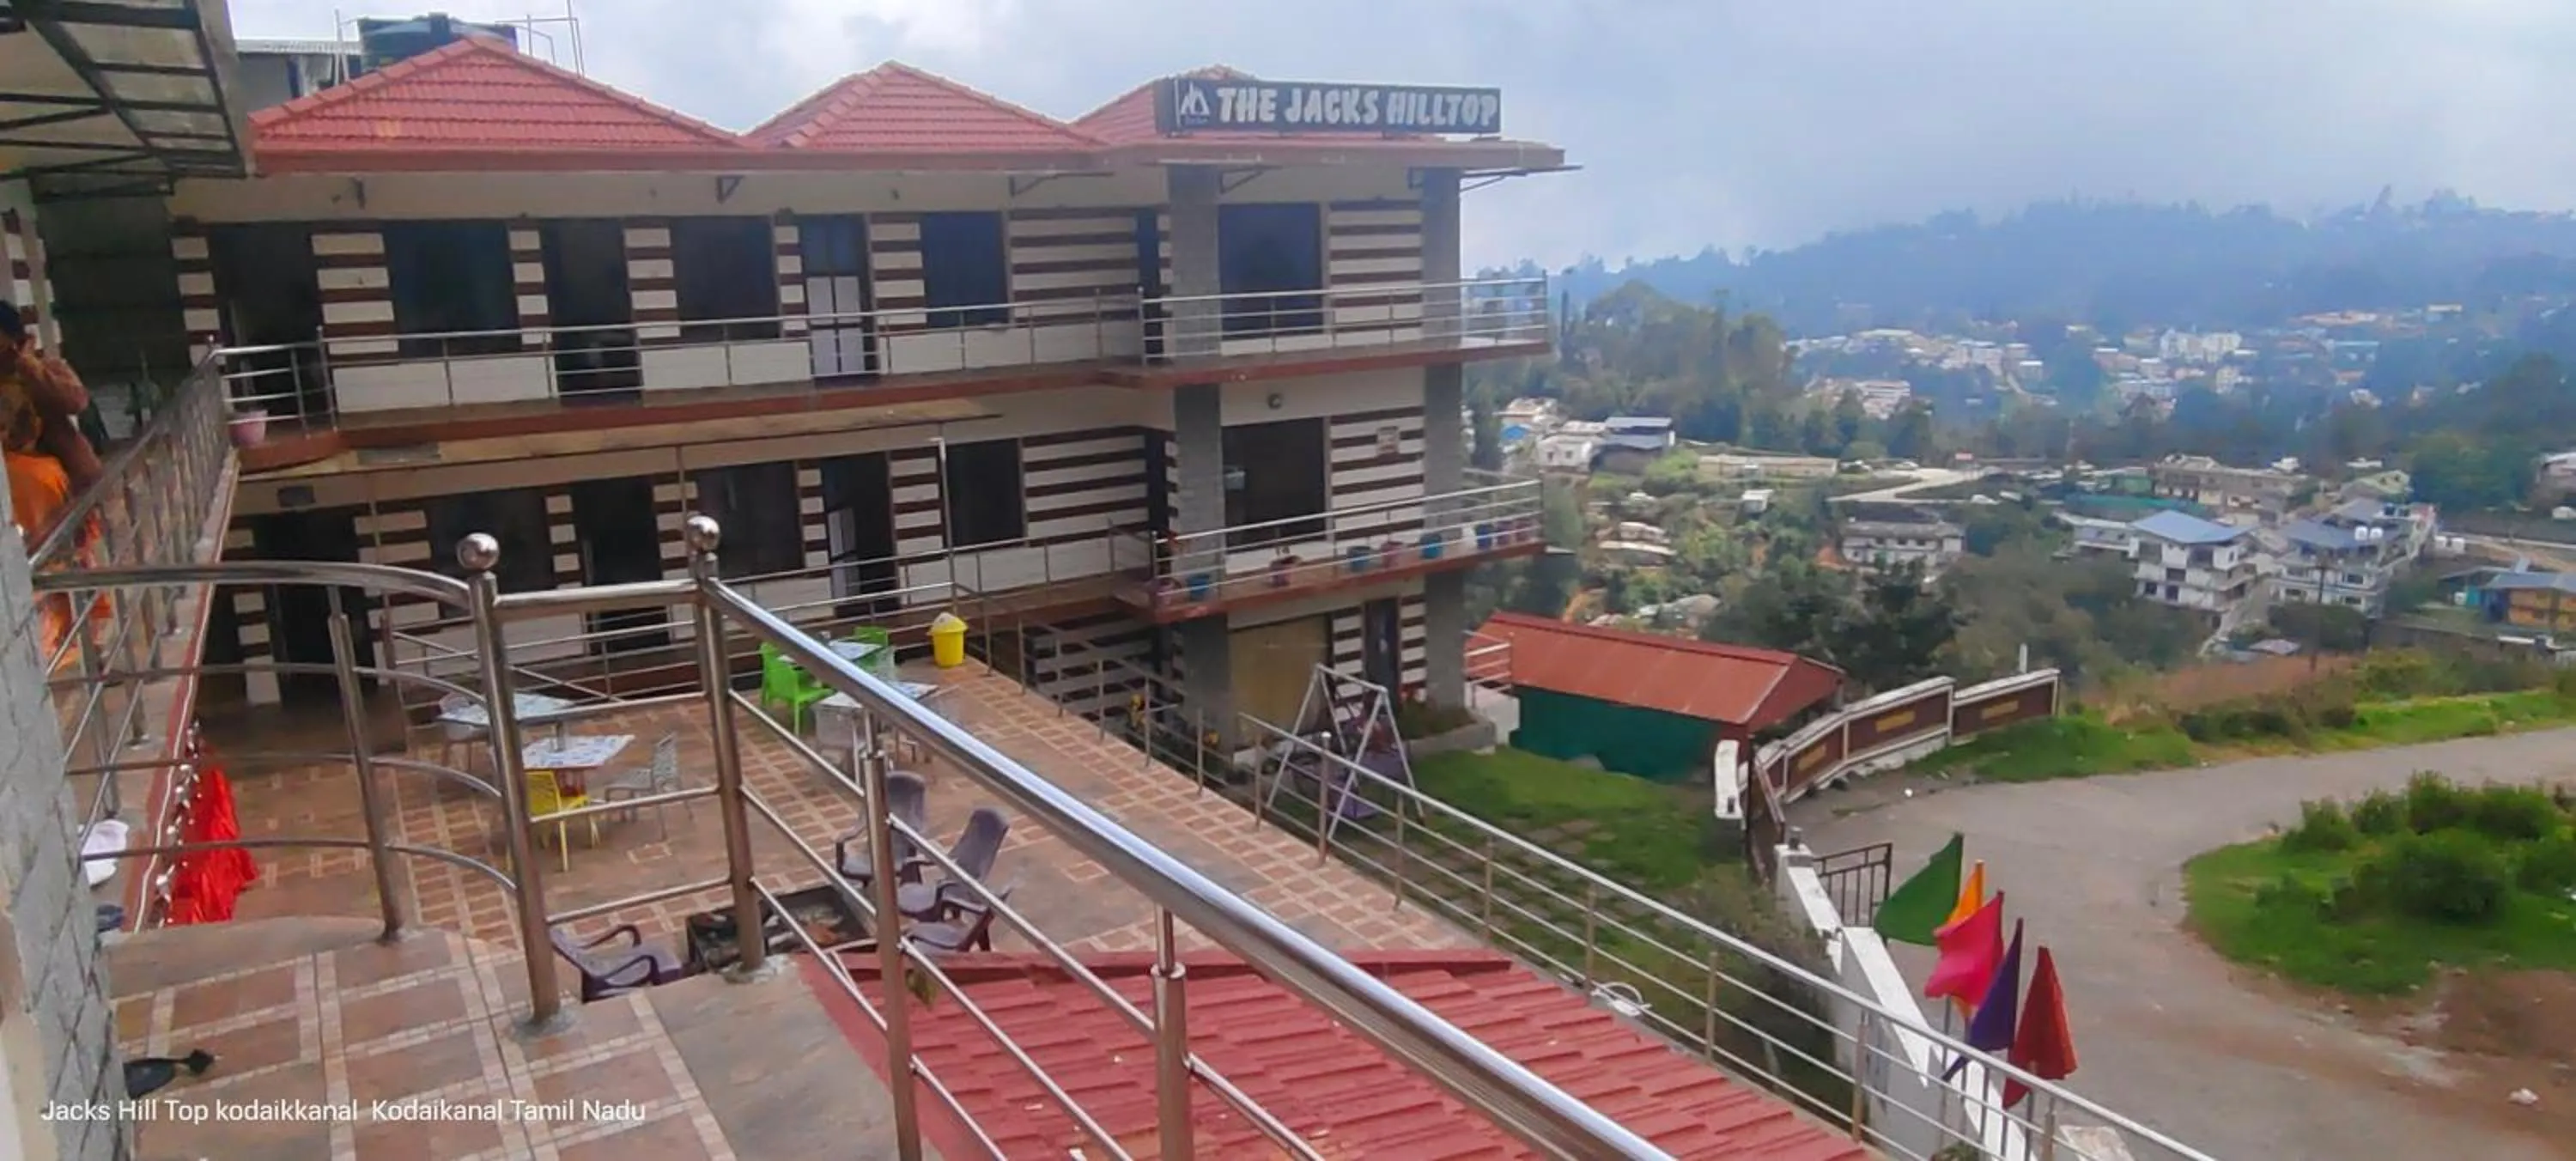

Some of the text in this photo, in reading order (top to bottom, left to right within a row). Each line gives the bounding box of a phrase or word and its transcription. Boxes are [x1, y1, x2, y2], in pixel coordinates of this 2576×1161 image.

[1218, 87, 1498, 127] THE JACKS HILLTOP
